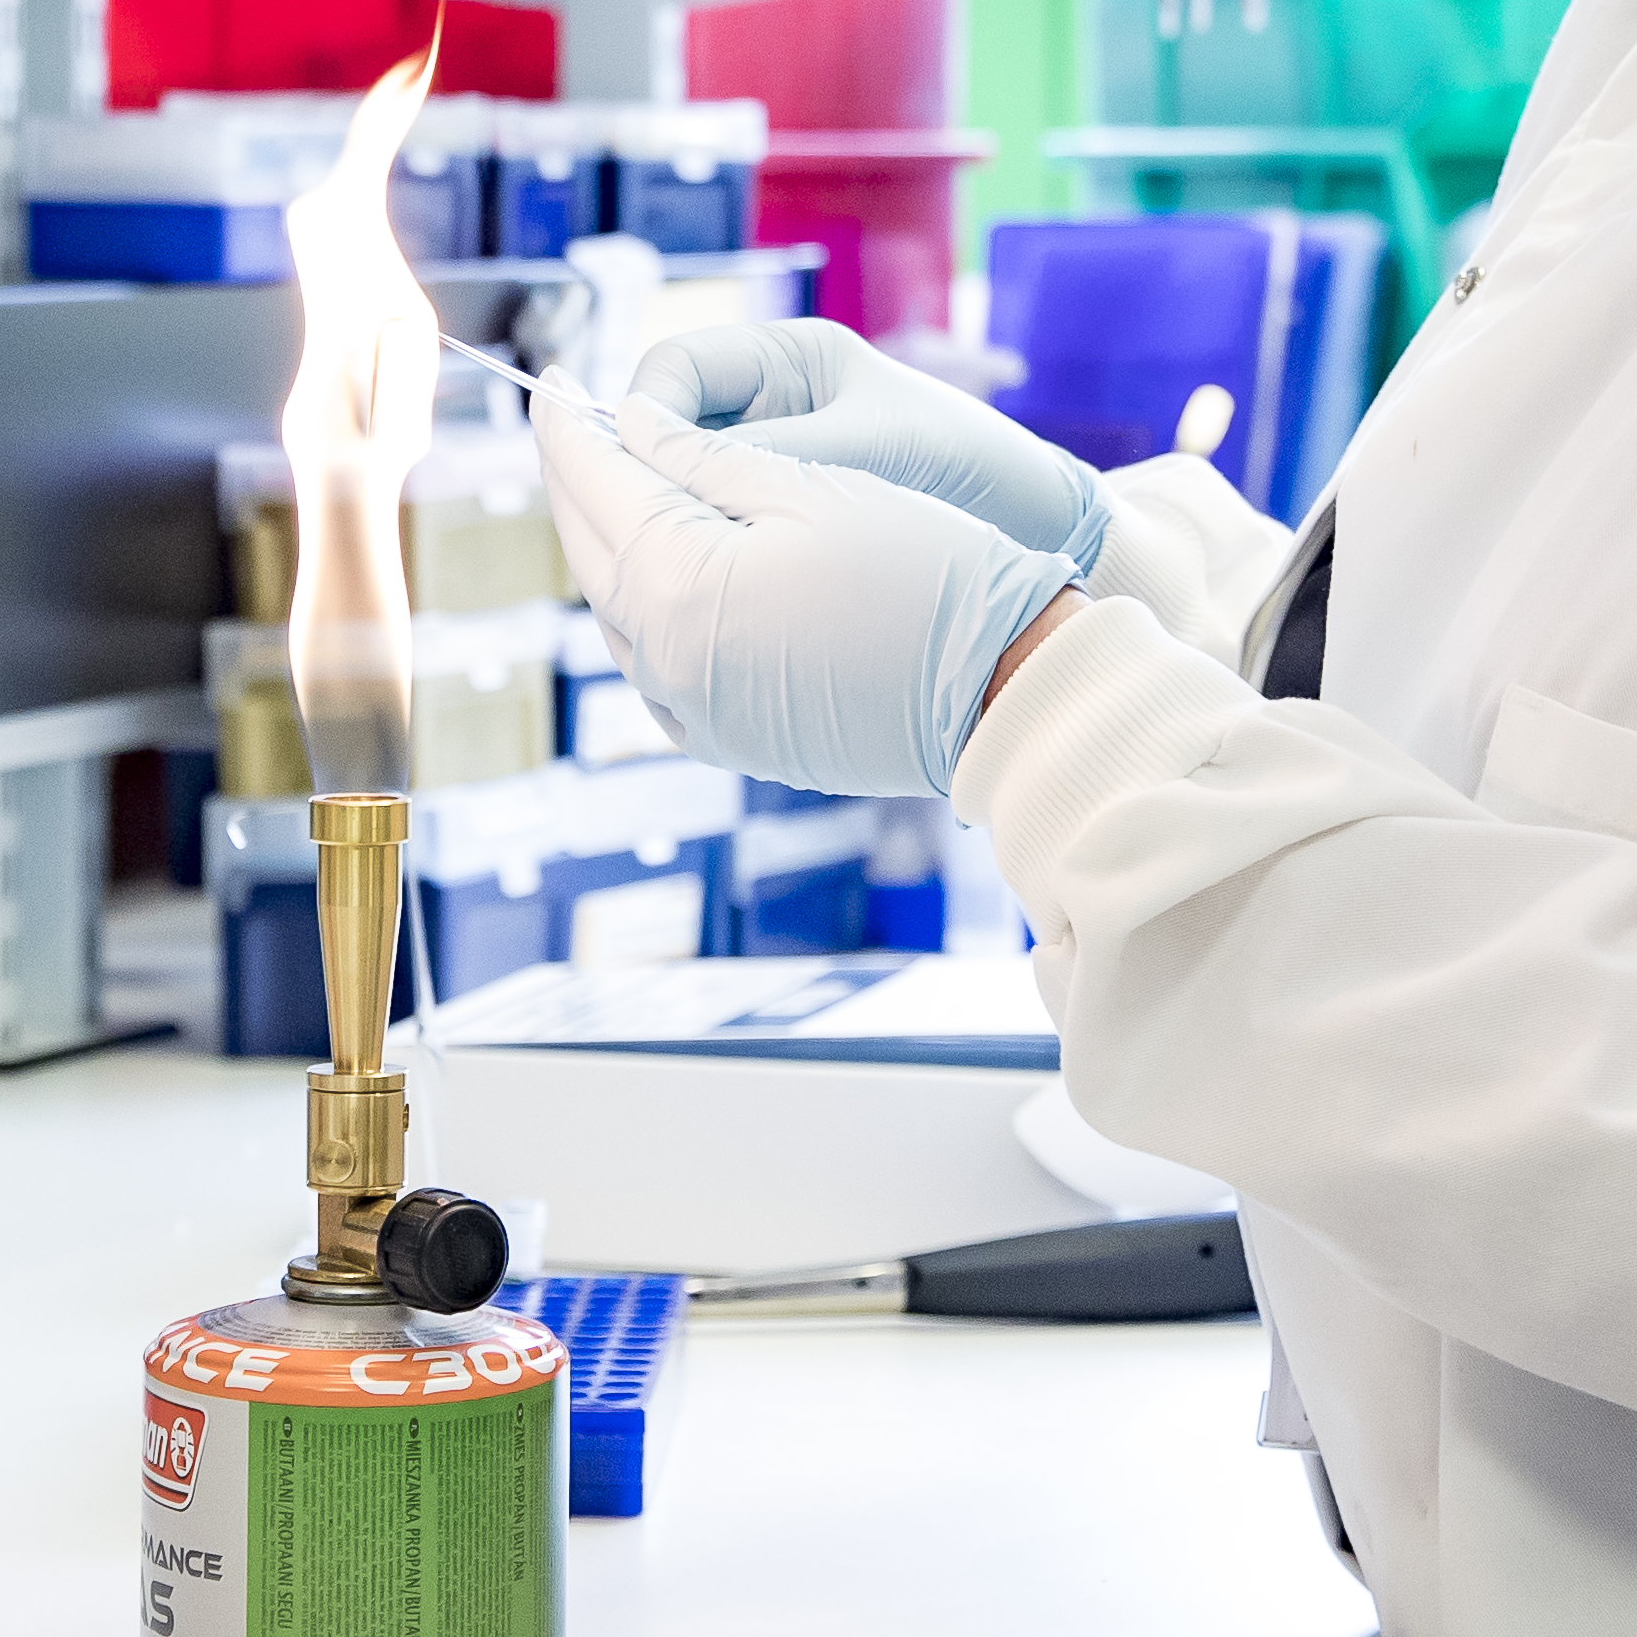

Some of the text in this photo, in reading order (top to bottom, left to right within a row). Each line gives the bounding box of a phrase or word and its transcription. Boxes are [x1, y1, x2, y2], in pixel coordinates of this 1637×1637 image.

[349, 1327, 565, 1396] C300
[514, 1424, 526, 1462] ZMES
[275, 1439, 295, 1587] BUTAANI/PROPAANI
[405, 1440, 422, 1524] MIESZANKA
[277, 1591, 294, 1631] SEGU
